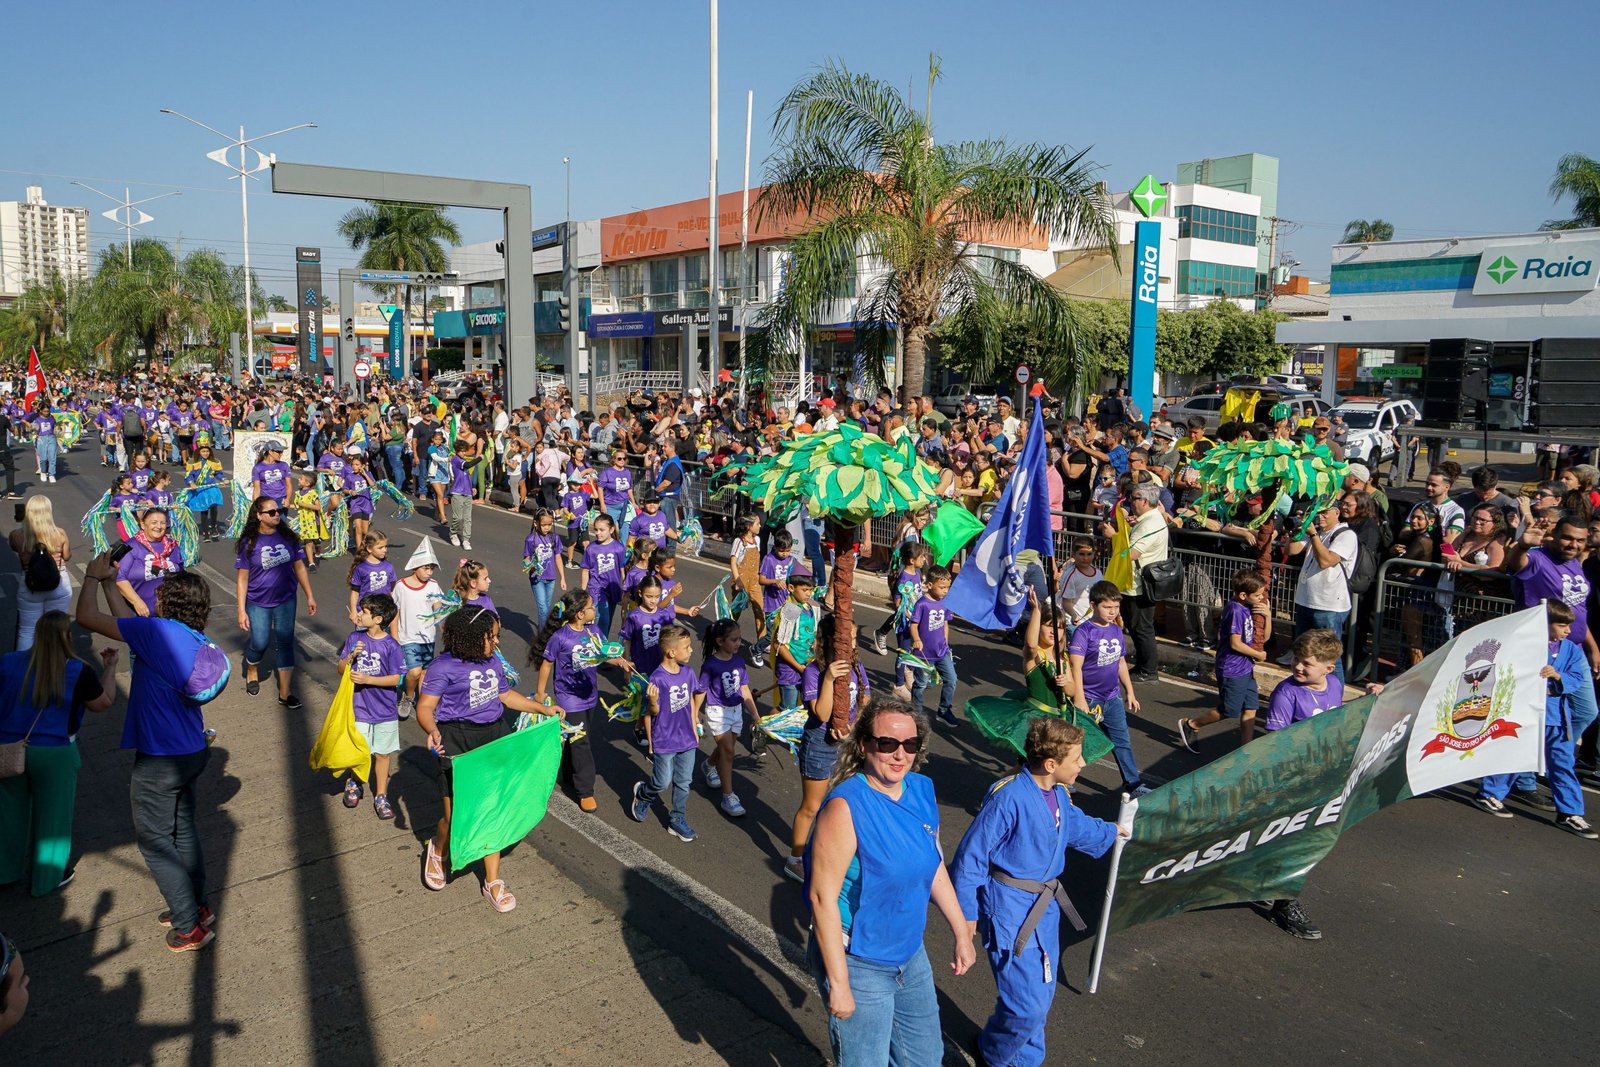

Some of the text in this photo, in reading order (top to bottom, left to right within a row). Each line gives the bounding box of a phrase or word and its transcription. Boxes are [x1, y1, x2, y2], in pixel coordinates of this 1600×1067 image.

[611, 227, 668, 257] Kelvin
[1139, 245, 1157, 304] Raia
[1522, 255, 1592, 280] Raia
[475, 313, 497, 326] SICOOB
[662, 313, 693, 325] Gallery
[1140, 830, 1251, 884] CASA
[1256, 806, 1317, 846] DE
